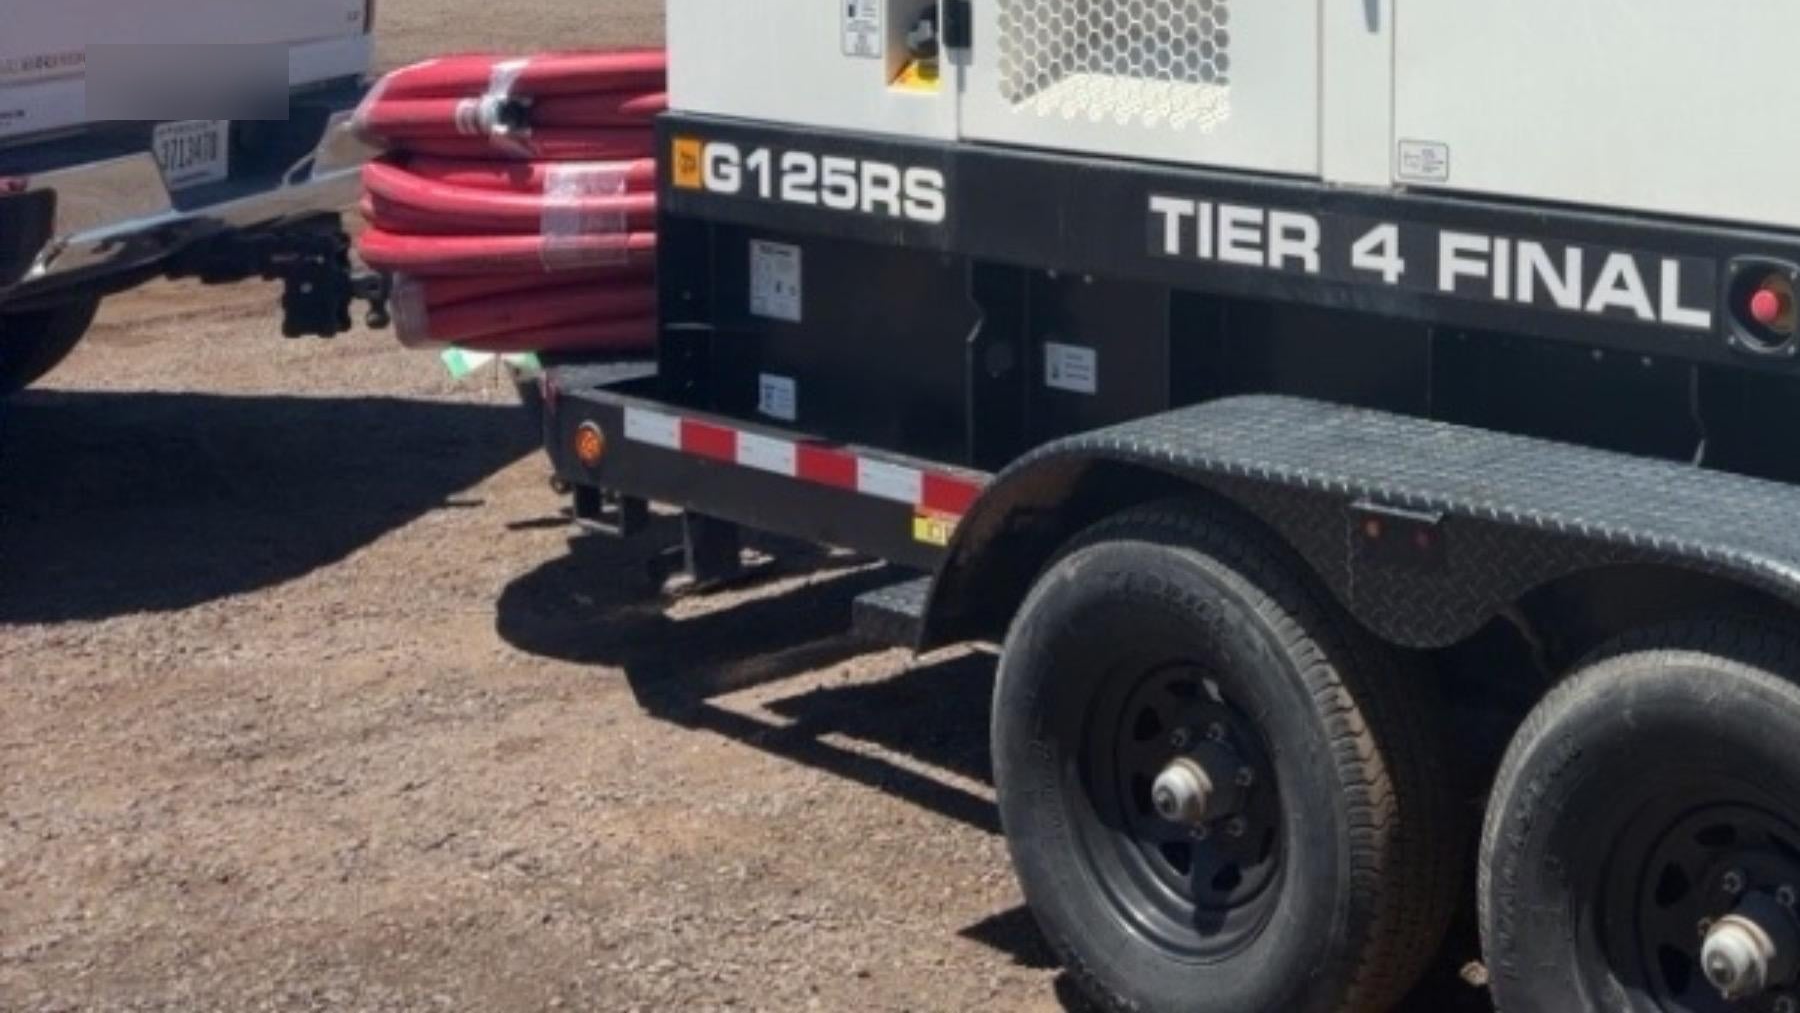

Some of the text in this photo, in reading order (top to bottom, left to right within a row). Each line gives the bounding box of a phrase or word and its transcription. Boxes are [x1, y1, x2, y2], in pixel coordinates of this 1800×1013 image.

[702, 141, 947, 225] G125RS
[1147, 194, 1713, 329] TIER 4 FINAL
